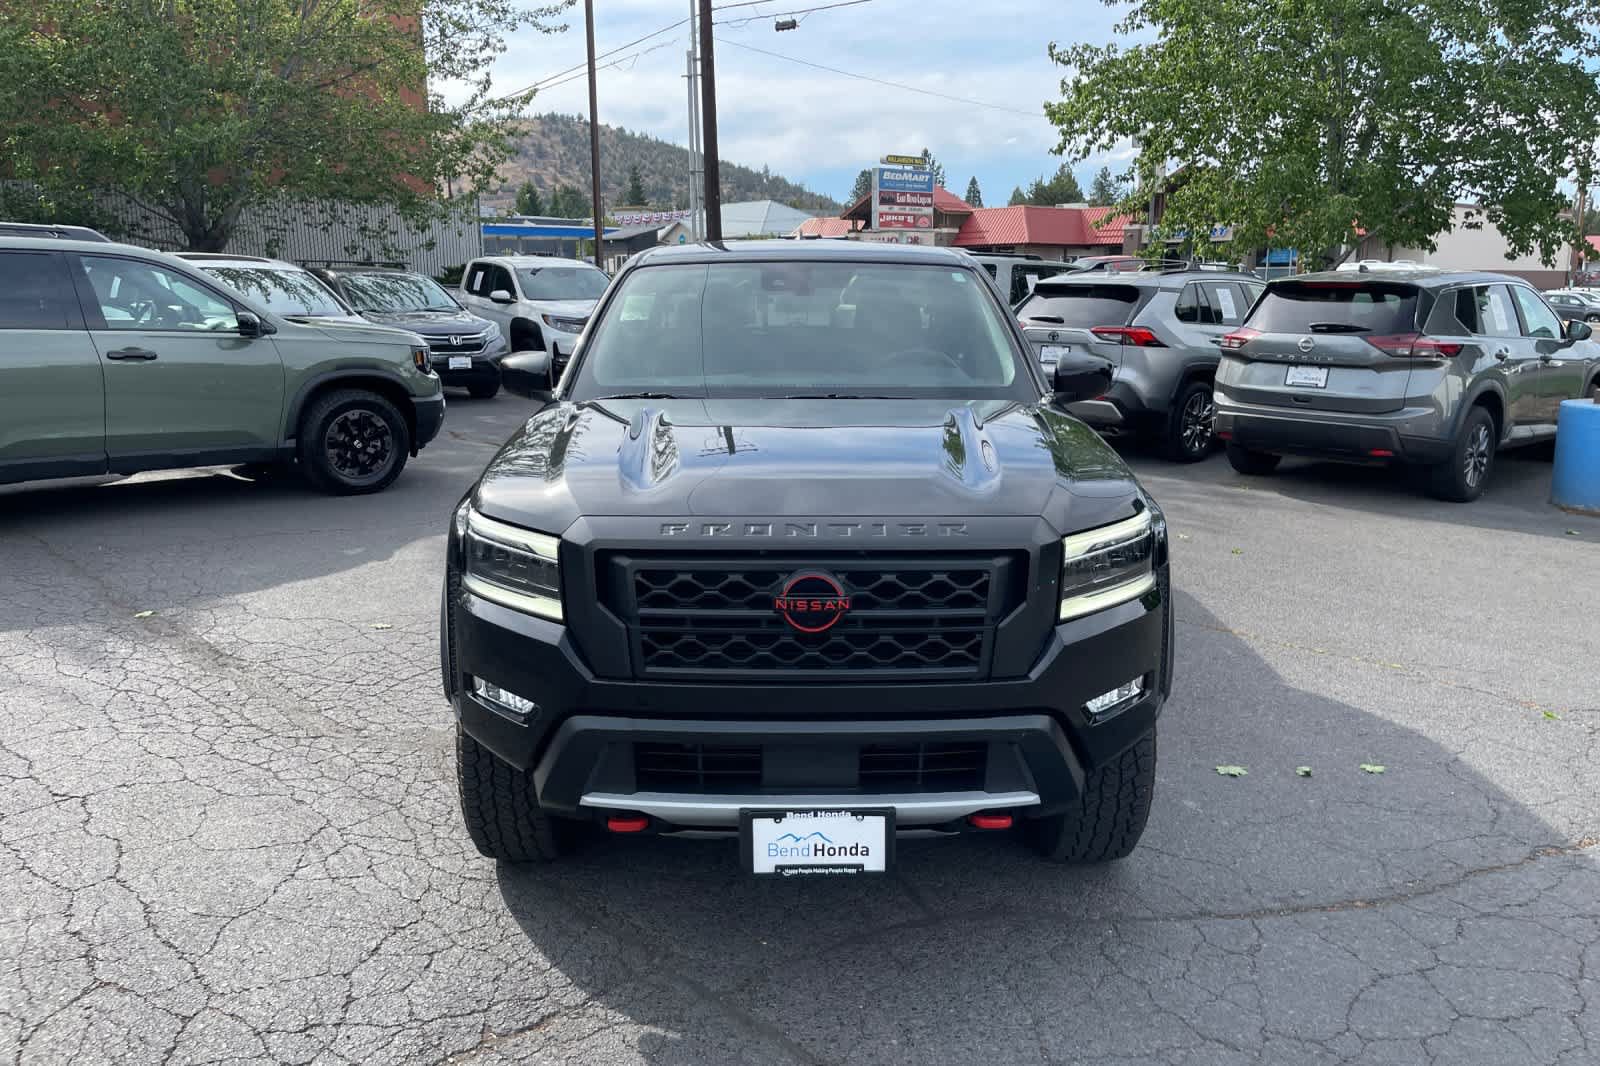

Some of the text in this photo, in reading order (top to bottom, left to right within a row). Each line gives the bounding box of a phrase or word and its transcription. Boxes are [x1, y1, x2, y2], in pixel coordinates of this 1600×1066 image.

[659, 522, 969, 537] FRONTIER
[775, 598, 850, 611] NISSAN
[817, 810, 852, 818] Honda
[768, 842, 870, 857] Bend Honda
